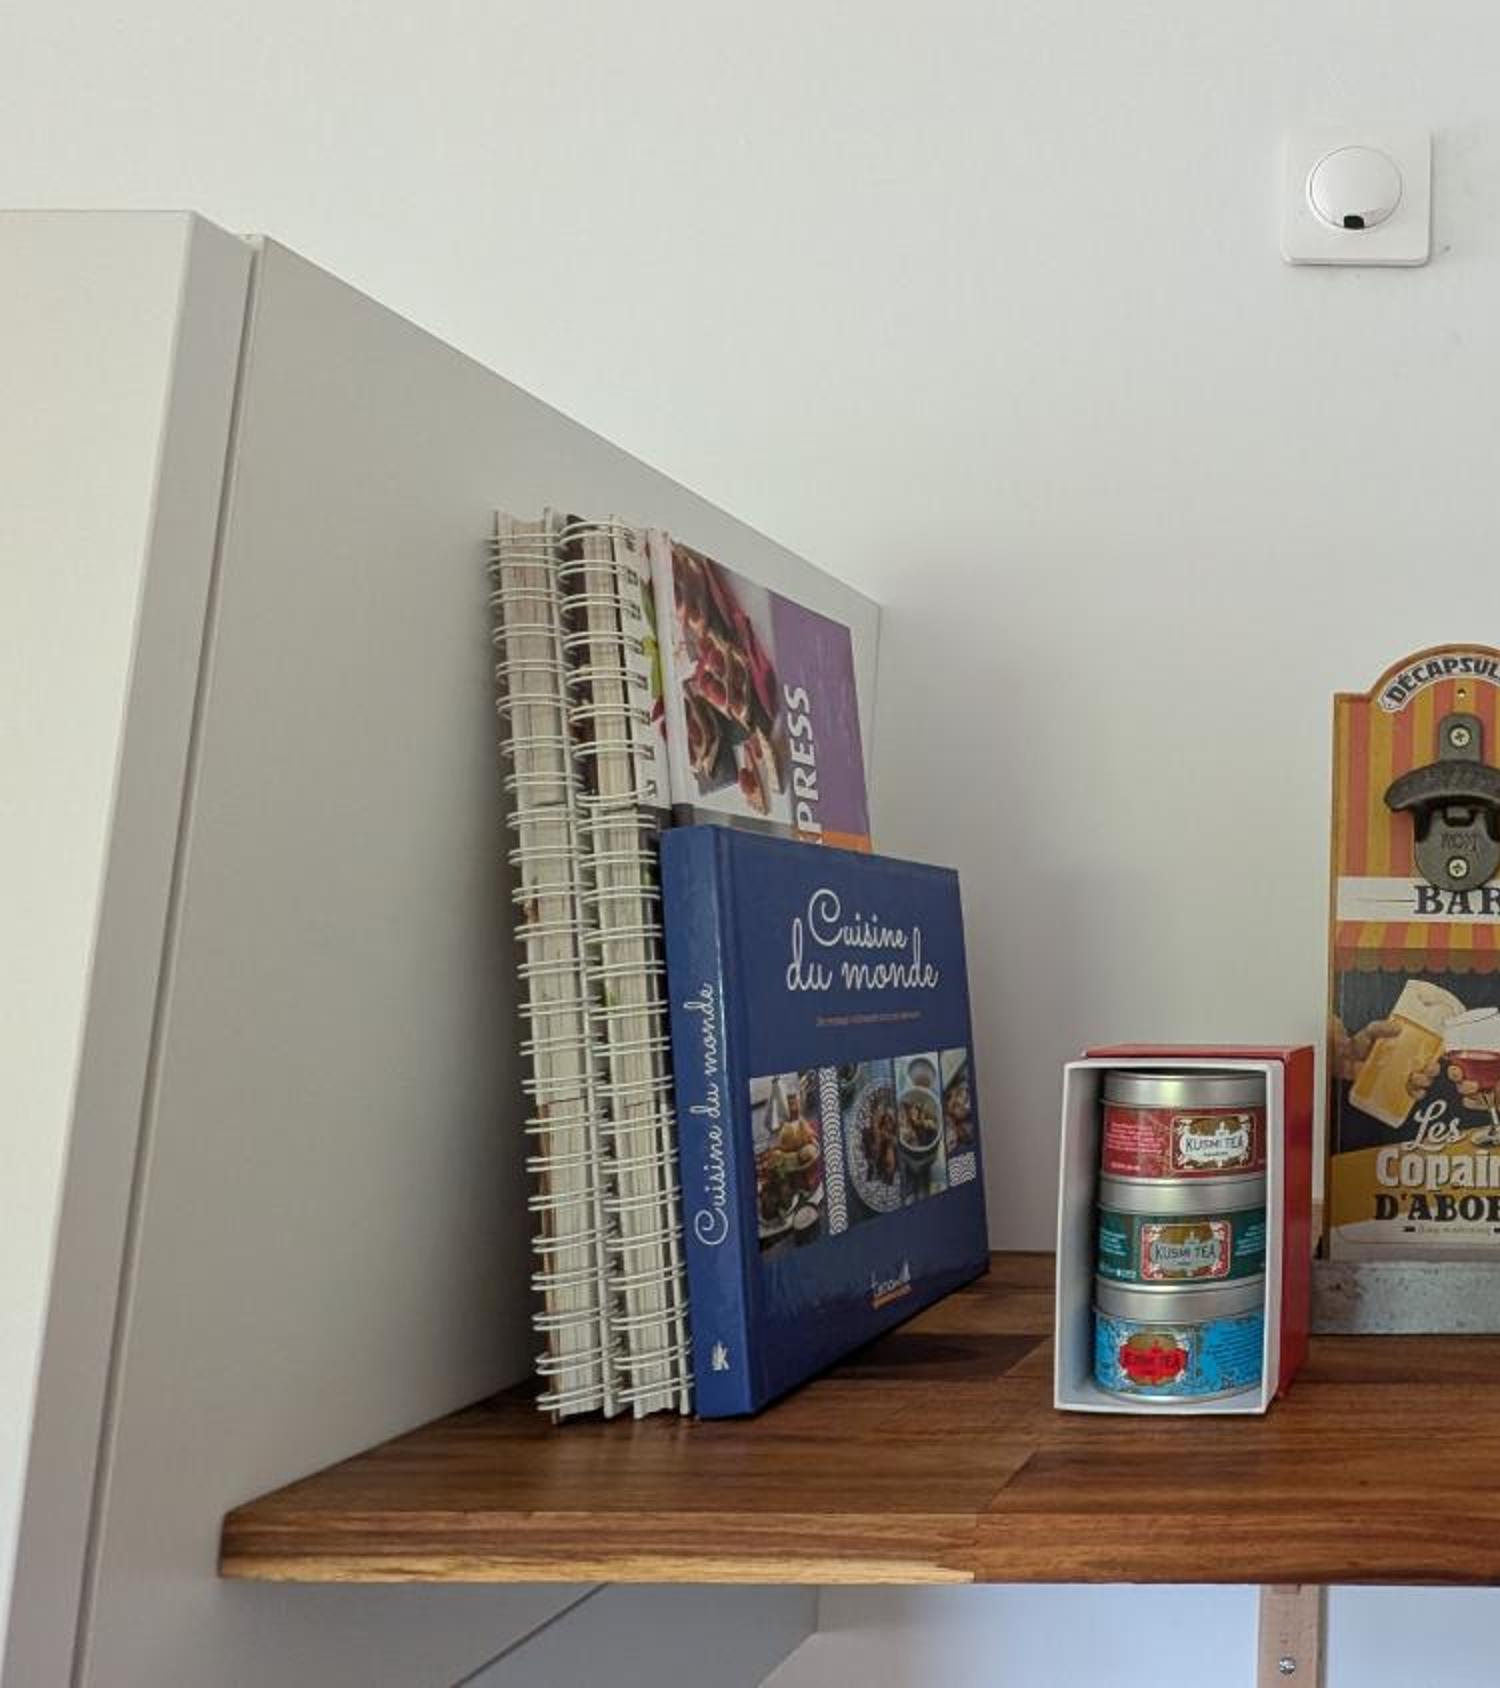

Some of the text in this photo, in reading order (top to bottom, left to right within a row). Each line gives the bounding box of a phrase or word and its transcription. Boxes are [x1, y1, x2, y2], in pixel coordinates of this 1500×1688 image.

[808, 888, 908, 948] Cuisine
[786, 917, 939, 991] du monde
[683, 983, 729, 1245] Cuisine du monde
[1400, 1099, 1466, 1151] Les
[1155, 1244, 1217, 1259] KUSMI TEA
